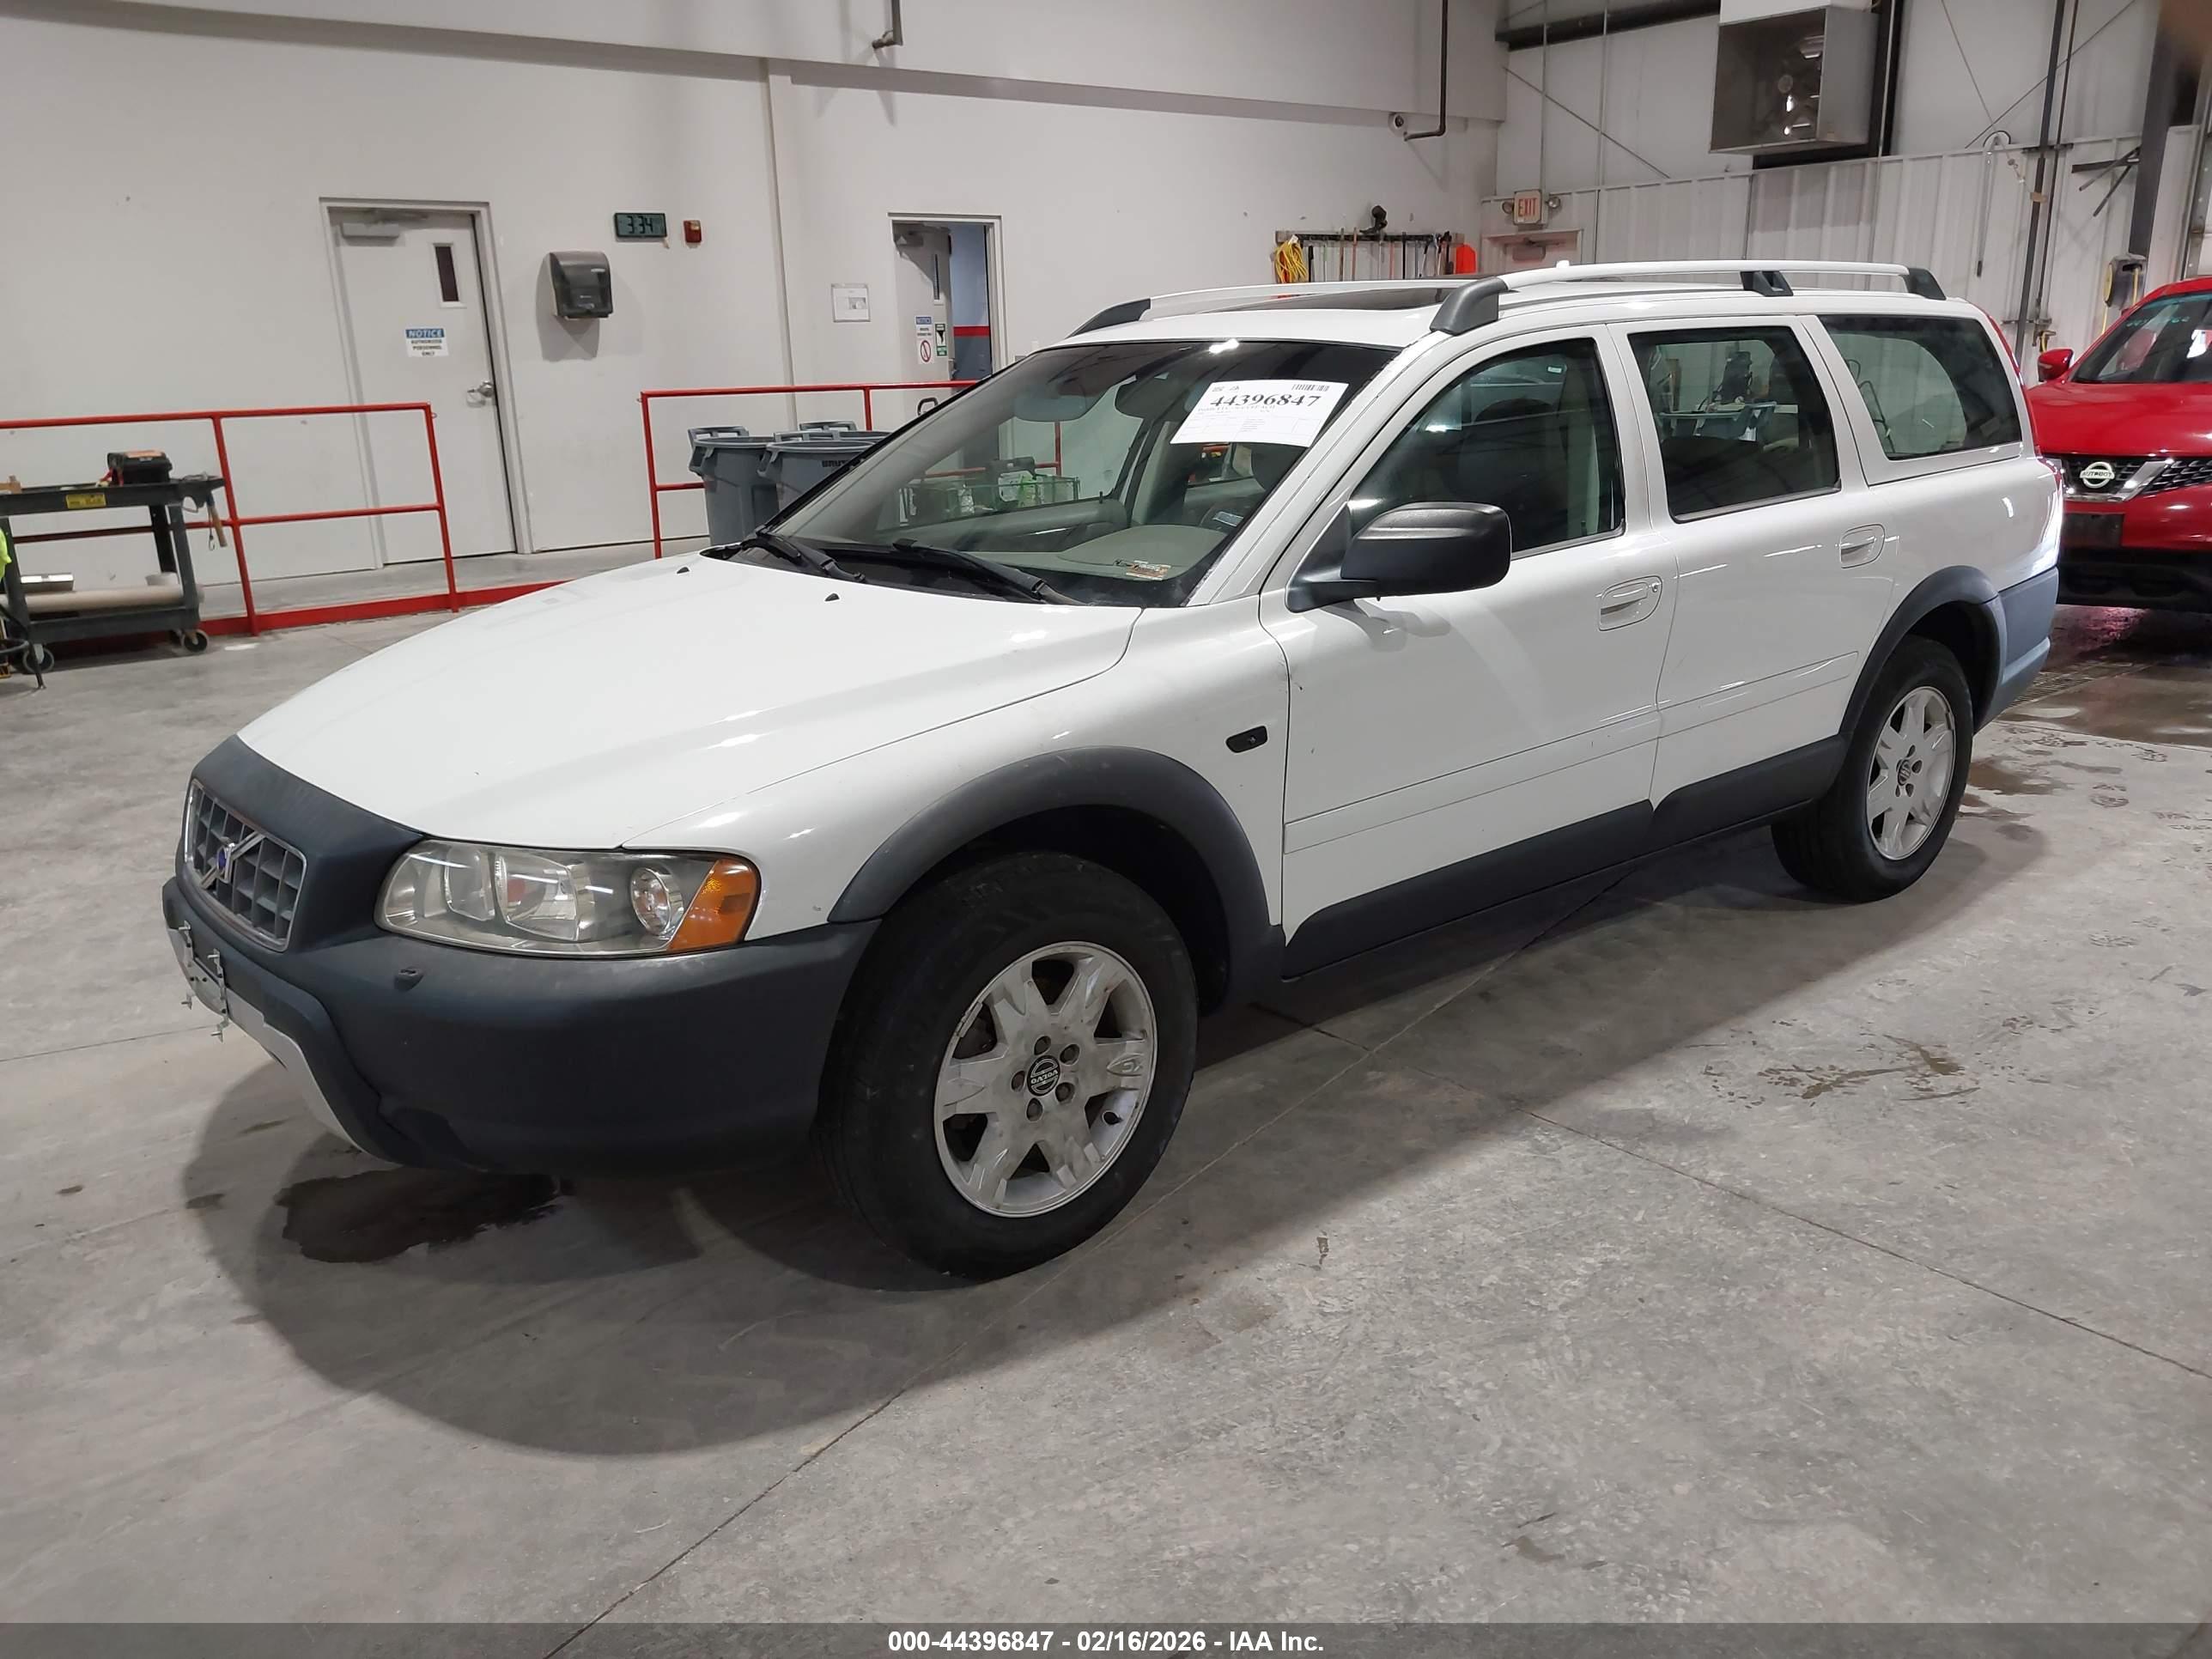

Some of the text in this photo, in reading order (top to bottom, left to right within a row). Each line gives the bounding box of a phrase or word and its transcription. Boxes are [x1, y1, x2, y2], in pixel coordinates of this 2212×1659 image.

[1517, 197, 1538, 217] EXIT
[408, 329, 442, 337] NOTICE
[1209, 393, 1322, 407] 44396847
[1030, 1069, 1059, 1085] VOLVO
